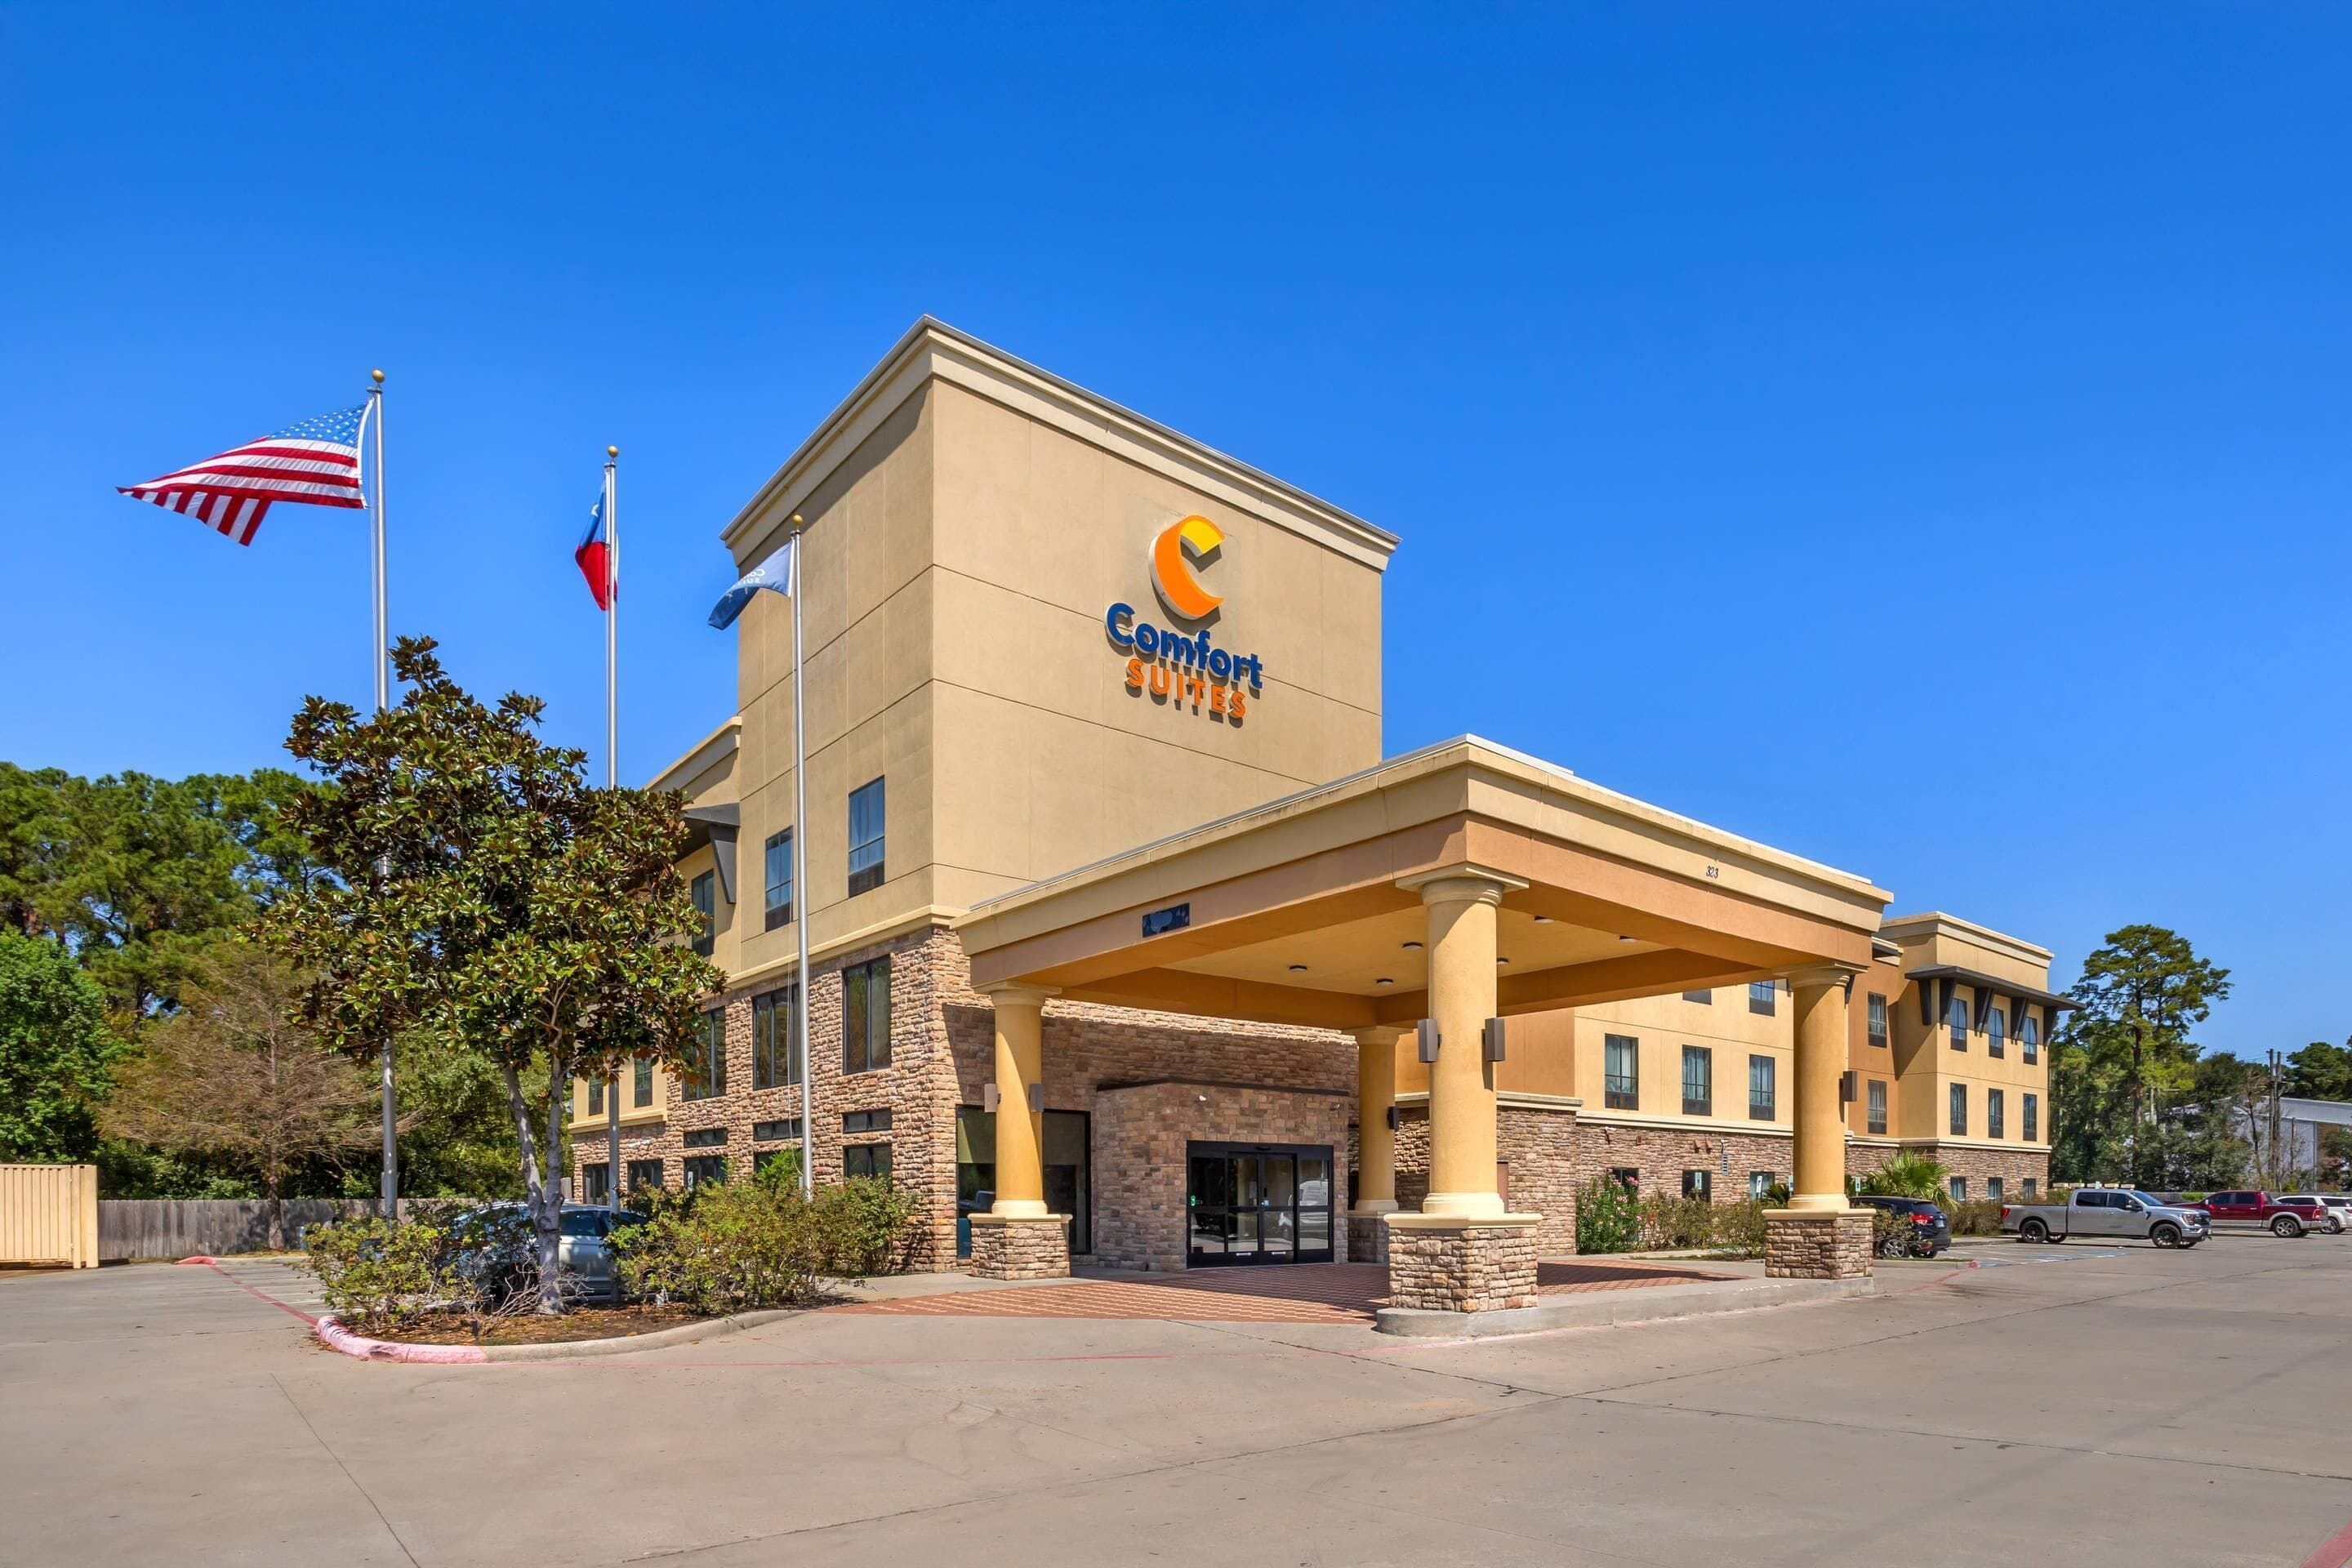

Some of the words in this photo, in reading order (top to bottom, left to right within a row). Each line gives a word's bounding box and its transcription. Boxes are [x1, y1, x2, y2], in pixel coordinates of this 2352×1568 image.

[1105, 602, 1263, 689] Comfort
[1125, 658, 1245, 719] SUITES
[1706, 866, 1718, 879] 323
